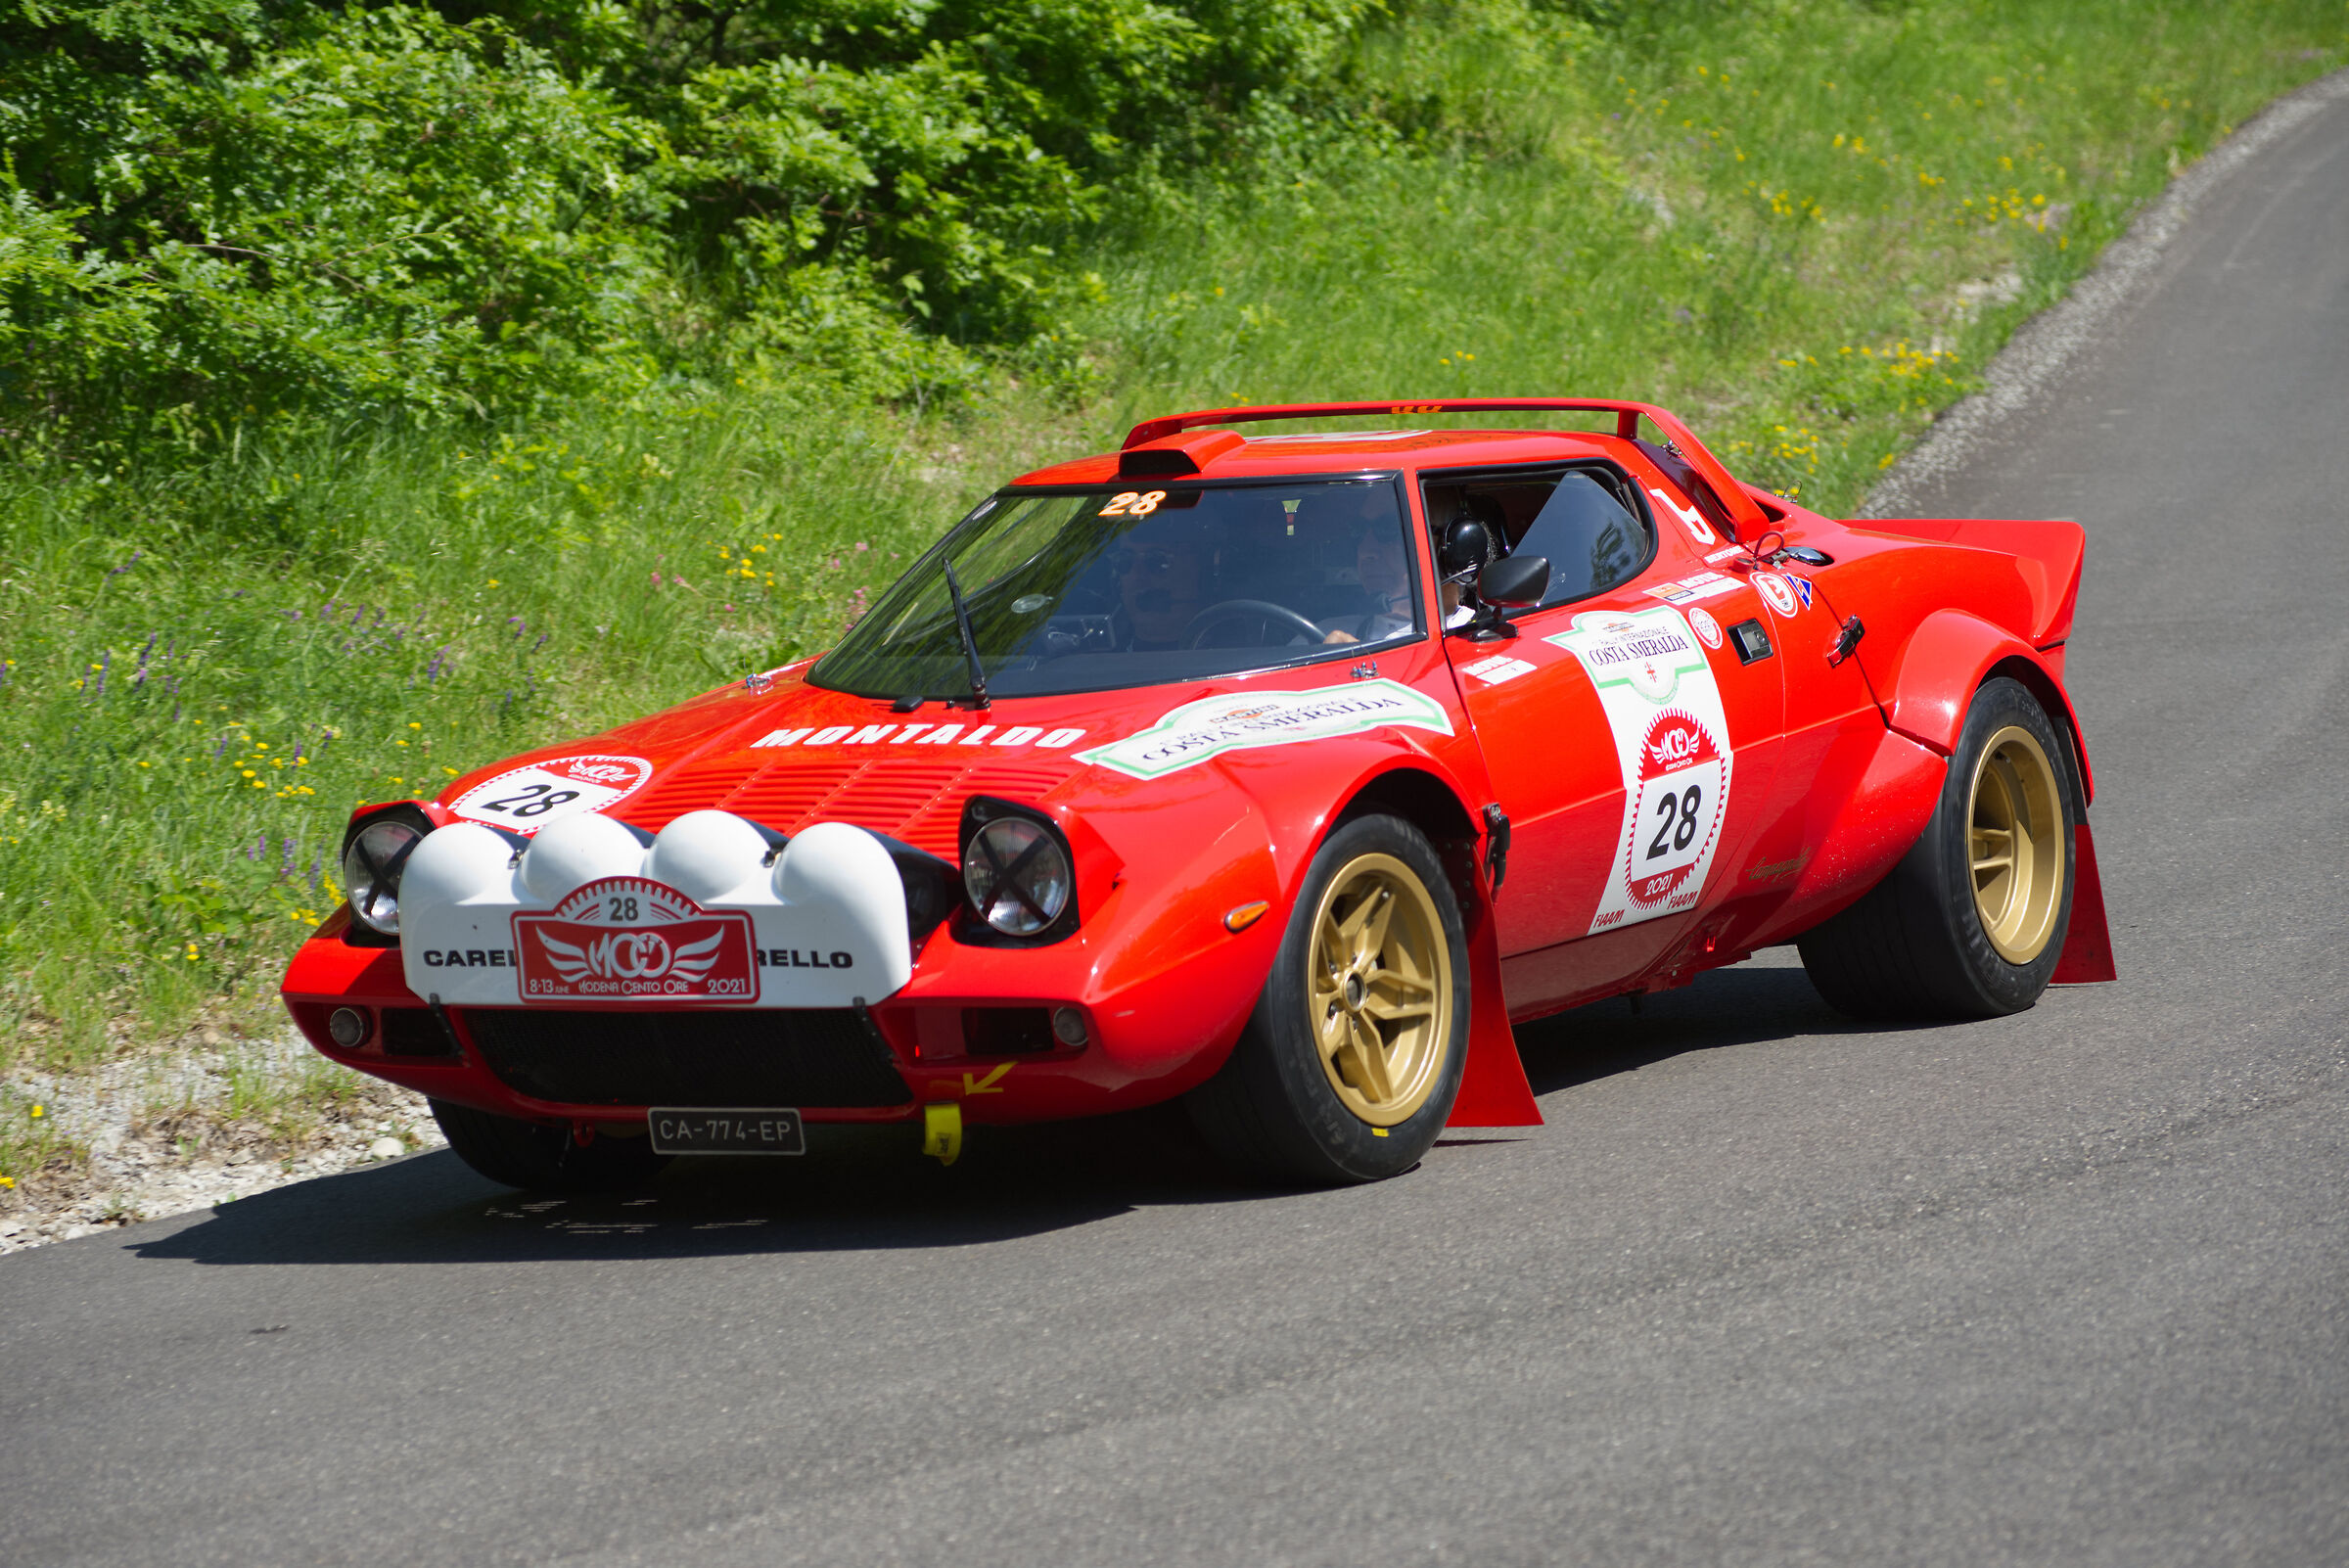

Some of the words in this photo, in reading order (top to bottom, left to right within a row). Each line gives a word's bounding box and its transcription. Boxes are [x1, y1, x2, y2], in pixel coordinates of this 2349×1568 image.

[1098, 489, 1167, 517] 28
[1589, 645, 1631, 667] COSTA
[1626, 634, 1689, 660] SMERALDA
[750, 723, 1086, 749] MONTALDO
[1142, 719, 1240, 763] COSTA
[1243, 696, 1405, 732] SMERALDA
[479, 784, 580, 817] 28
[1645, 784, 1702, 861] 28
[1644, 872, 1674, 898] 2021
[608, 897, 639, 922] 28
[578, 979, 619, 994] MODENA
[621, 979, 661, 995] CENTO
[664, 979, 688, 994] ORE
[708, 978, 746, 994] 2021
[659, 1119, 791, 1142] CA-774-EP
